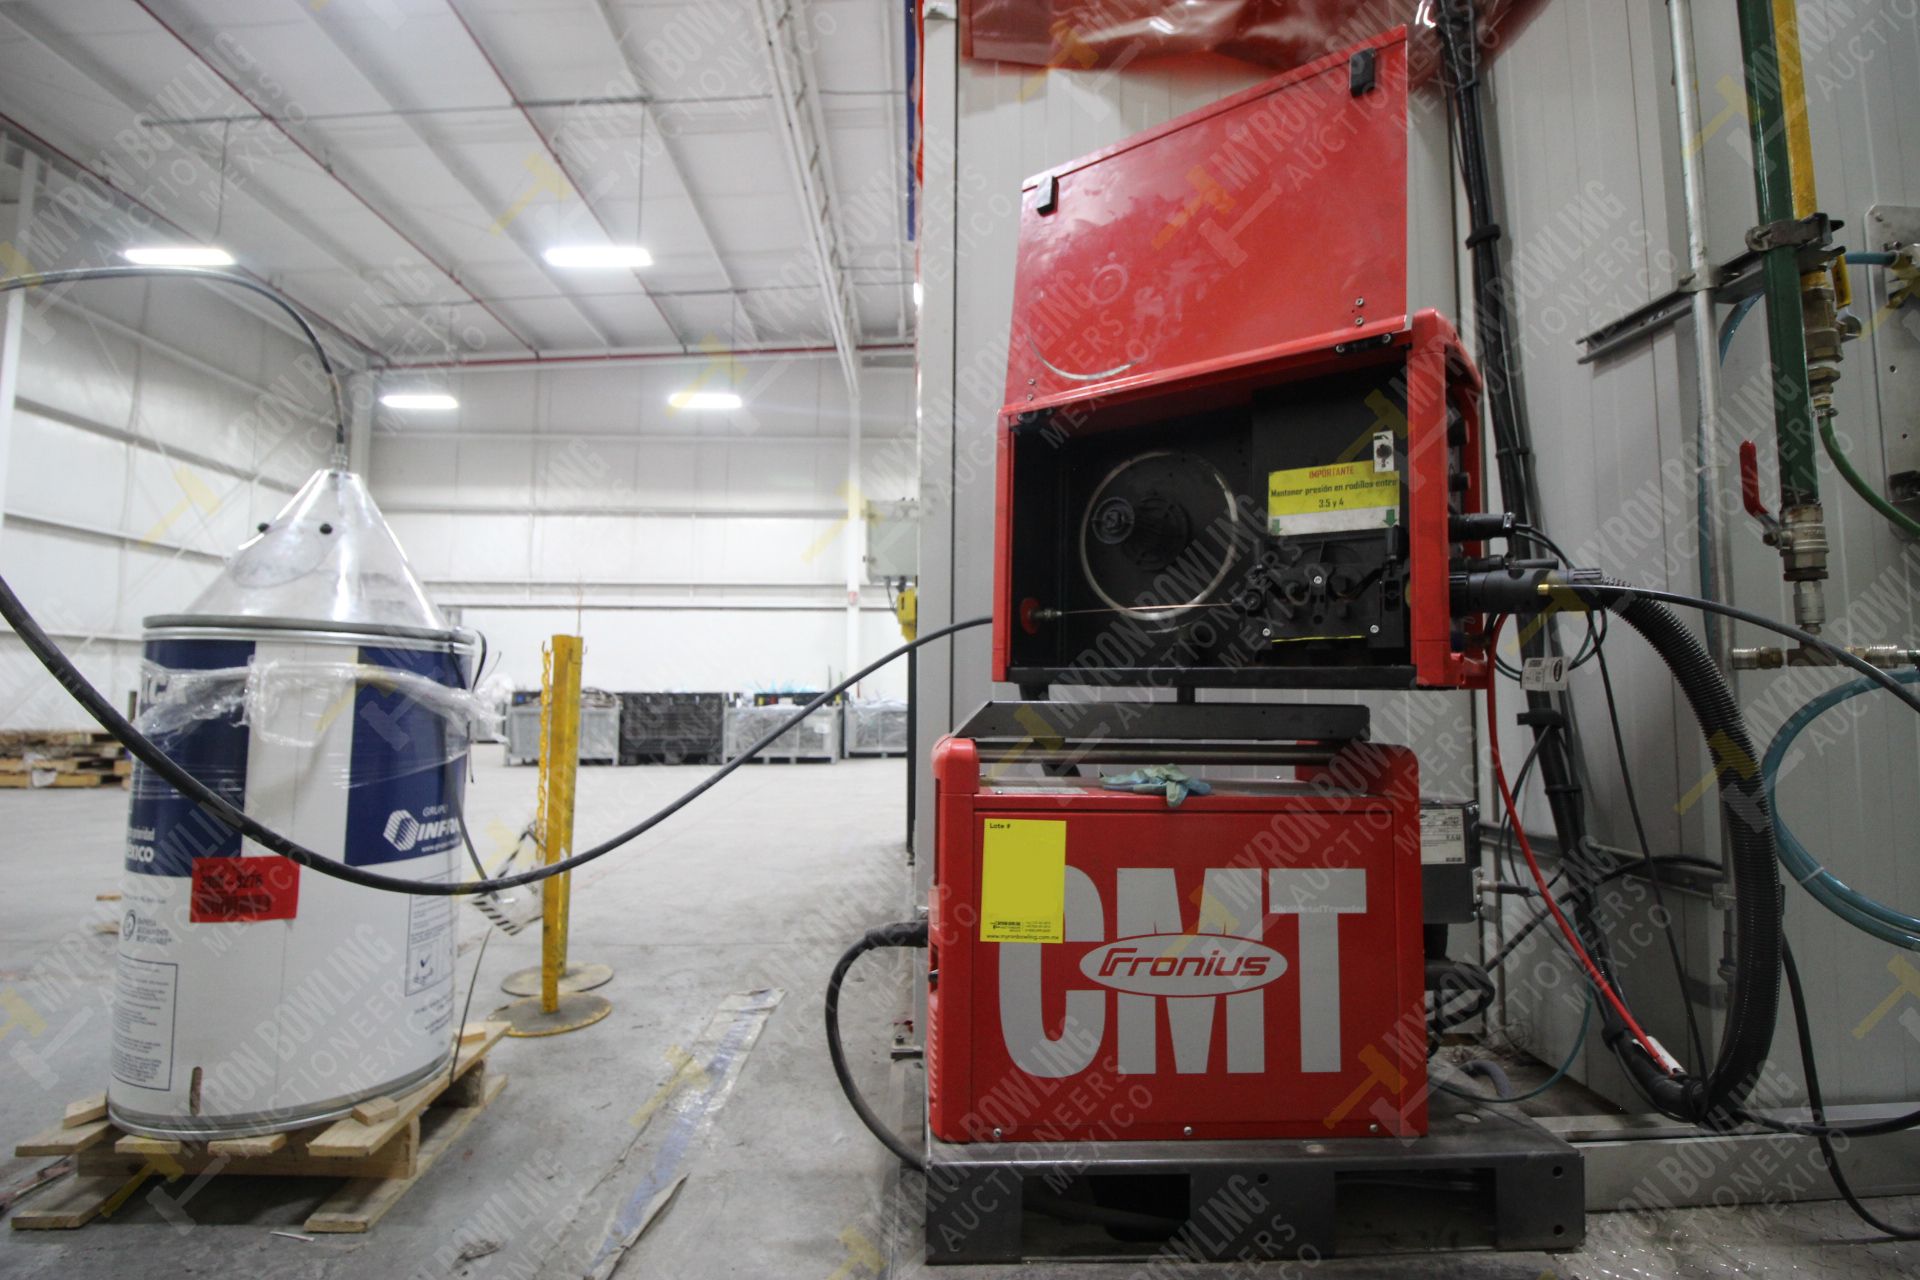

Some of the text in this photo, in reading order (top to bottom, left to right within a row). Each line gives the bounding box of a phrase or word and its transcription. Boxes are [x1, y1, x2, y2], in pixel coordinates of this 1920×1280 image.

[1309, 466, 1354, 479] IMPORTANTE
[1305, 484, 1333, 496] presión
[1334, 484, 1343, 492] en
[1345, 480, 1373, 490] rodillos
[1338, 498, 1344, 506] 4
[1098, 947, 1271, 977] Fronius
[998, 865, 1367, 1078] CMT
